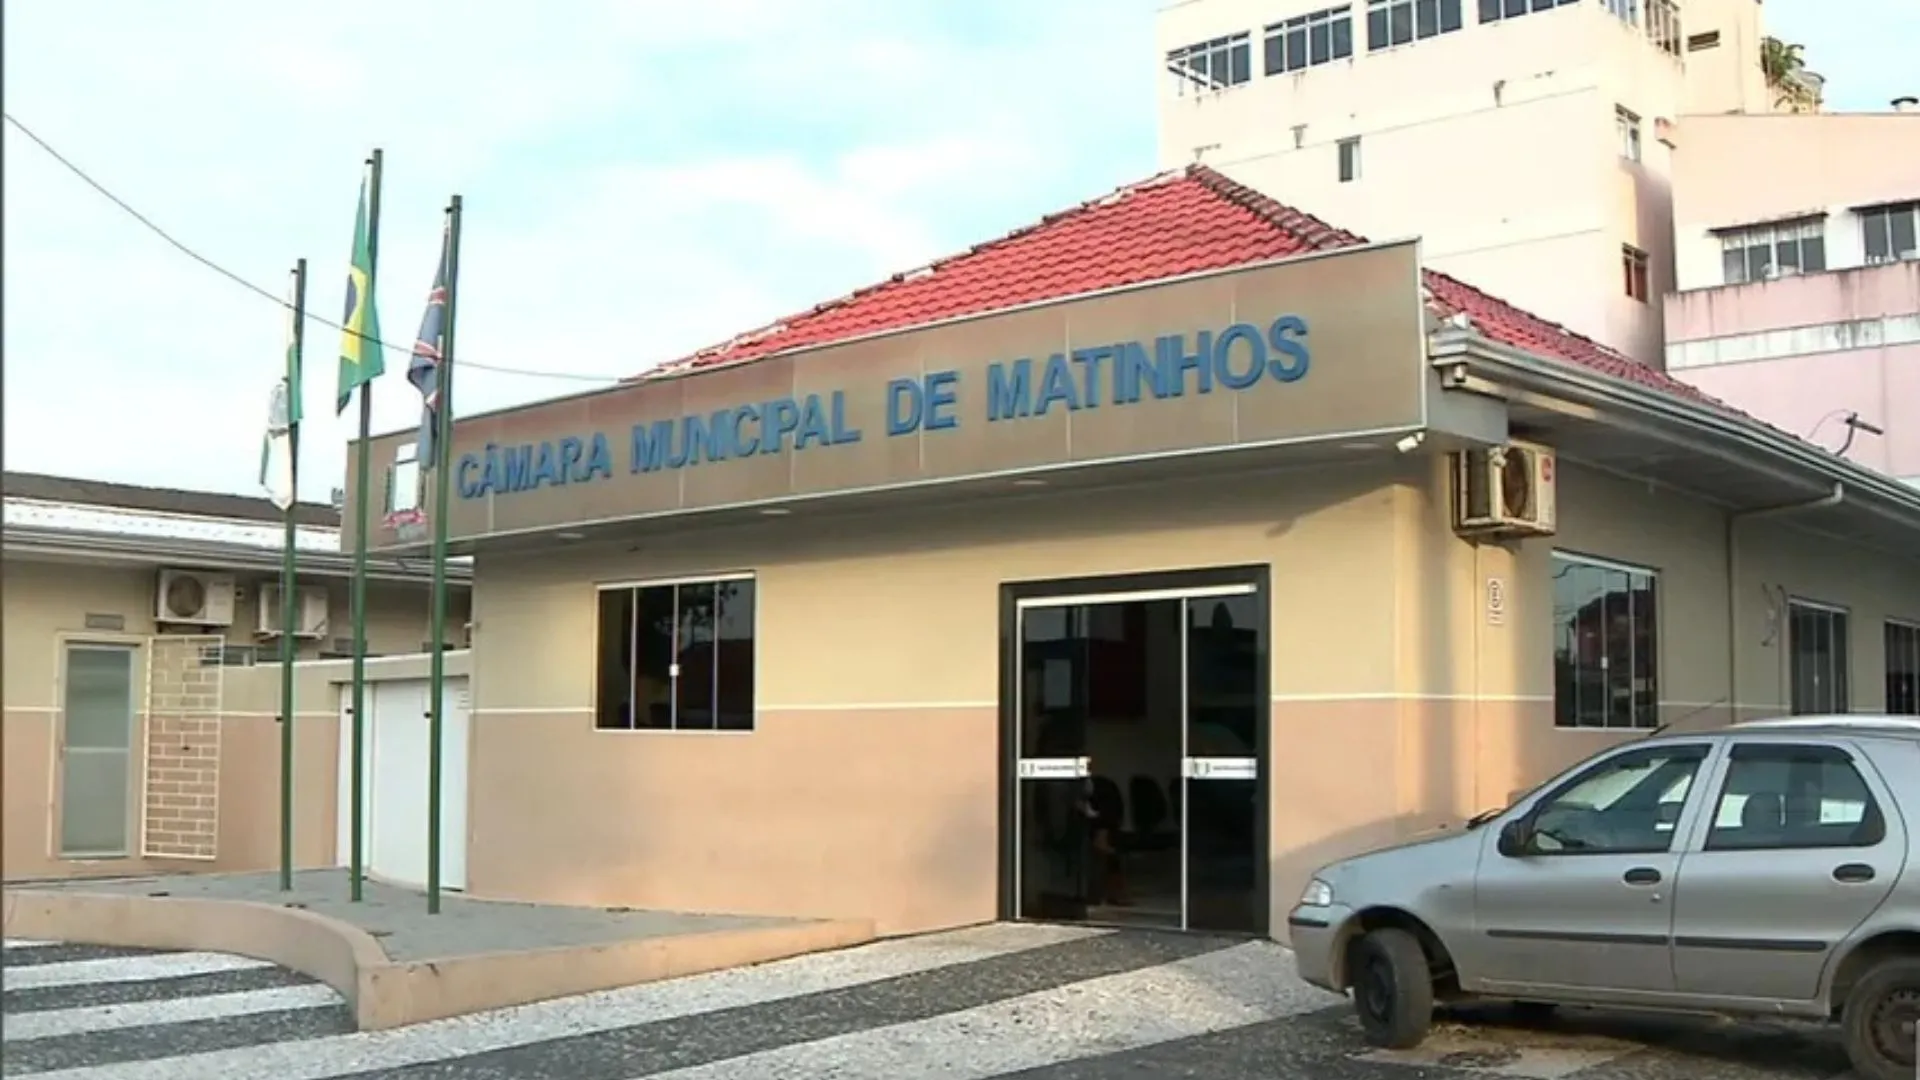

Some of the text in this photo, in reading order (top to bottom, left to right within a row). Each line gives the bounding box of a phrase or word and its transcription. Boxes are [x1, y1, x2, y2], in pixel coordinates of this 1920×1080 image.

[456, 315, 1311, 499] CÂMARA MUNICIPAL DE MATINHOS
